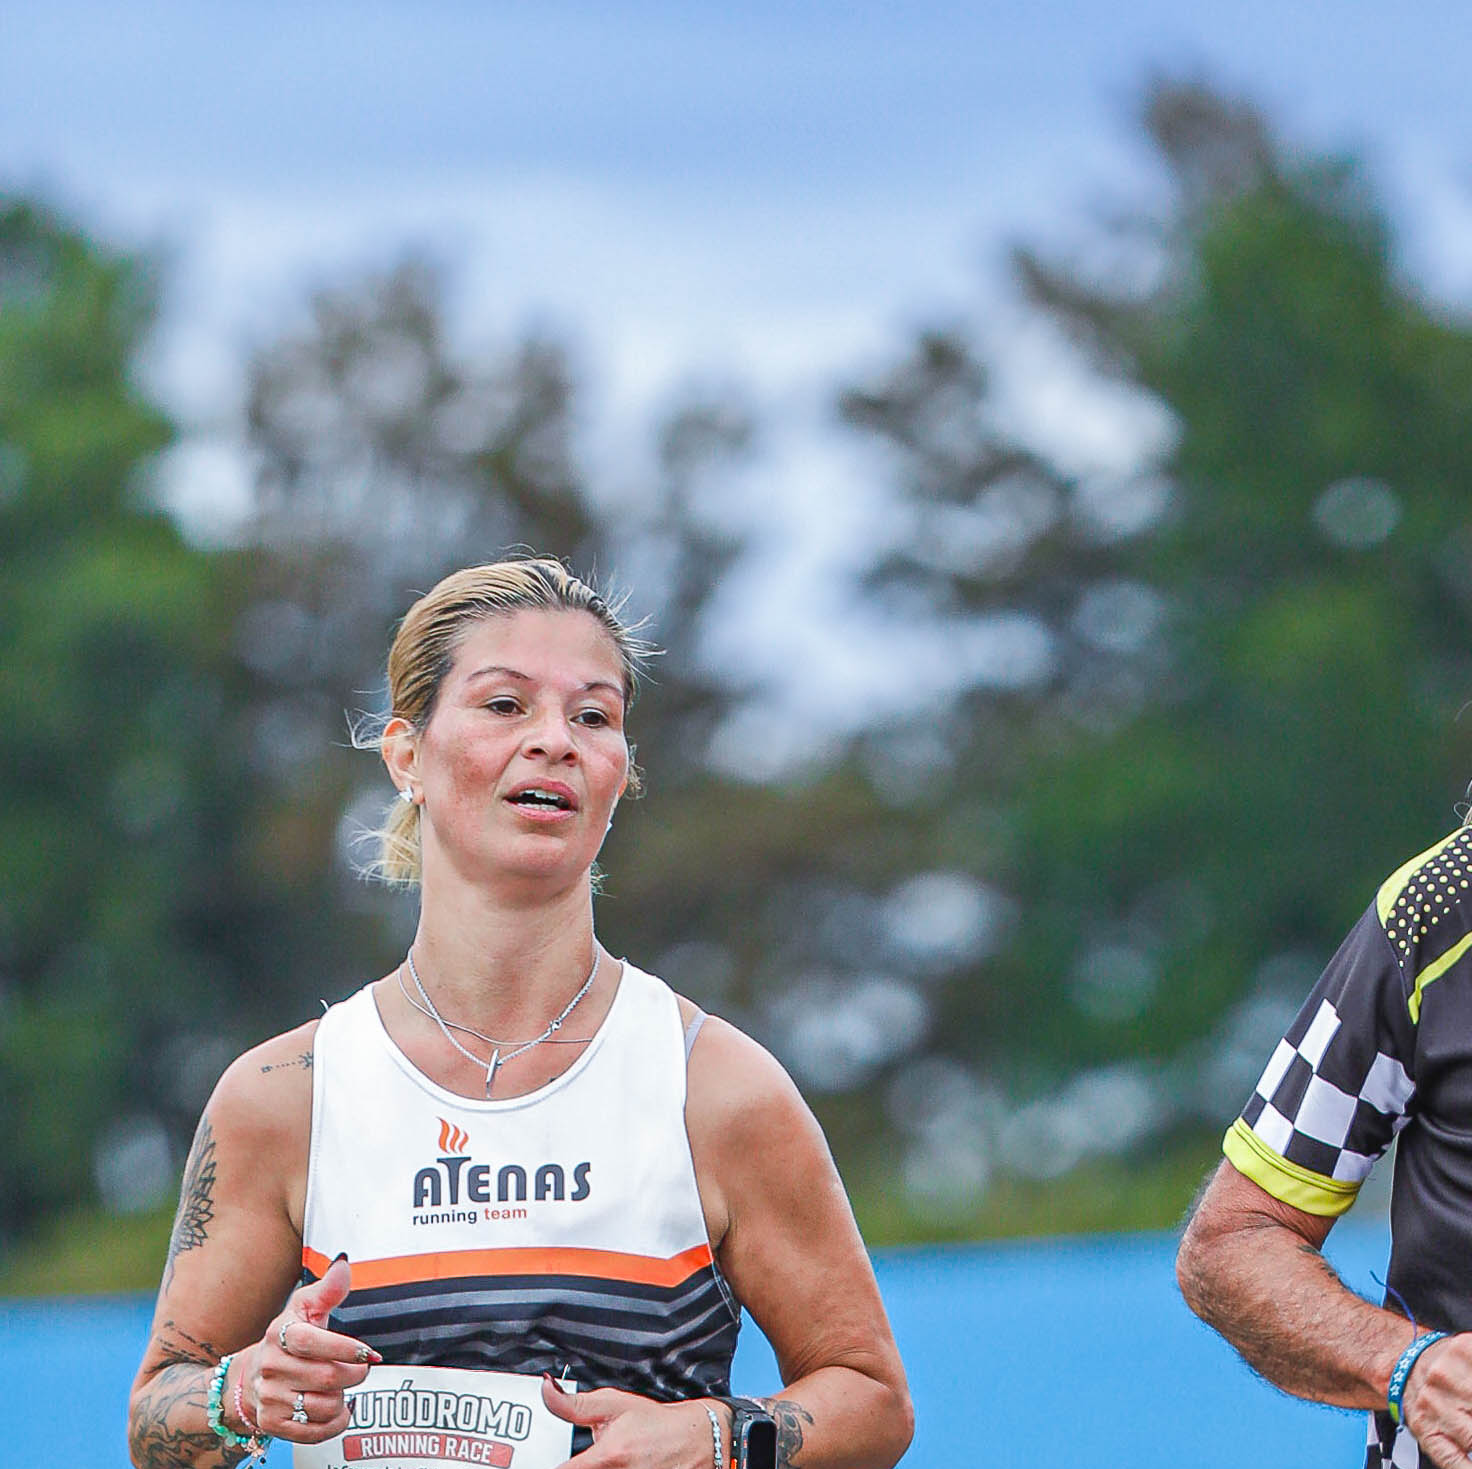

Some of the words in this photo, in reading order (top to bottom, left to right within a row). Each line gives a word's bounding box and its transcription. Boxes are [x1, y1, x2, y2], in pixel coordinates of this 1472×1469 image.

[413, 1156, 591, 1208] ATENAS
[412, 1209, 478, 1226] running
[484, 1207, 528, 1220] team
[360, 1435, 440, 1459] RUNNING
[444, 1438, 493, 1464] RACE
